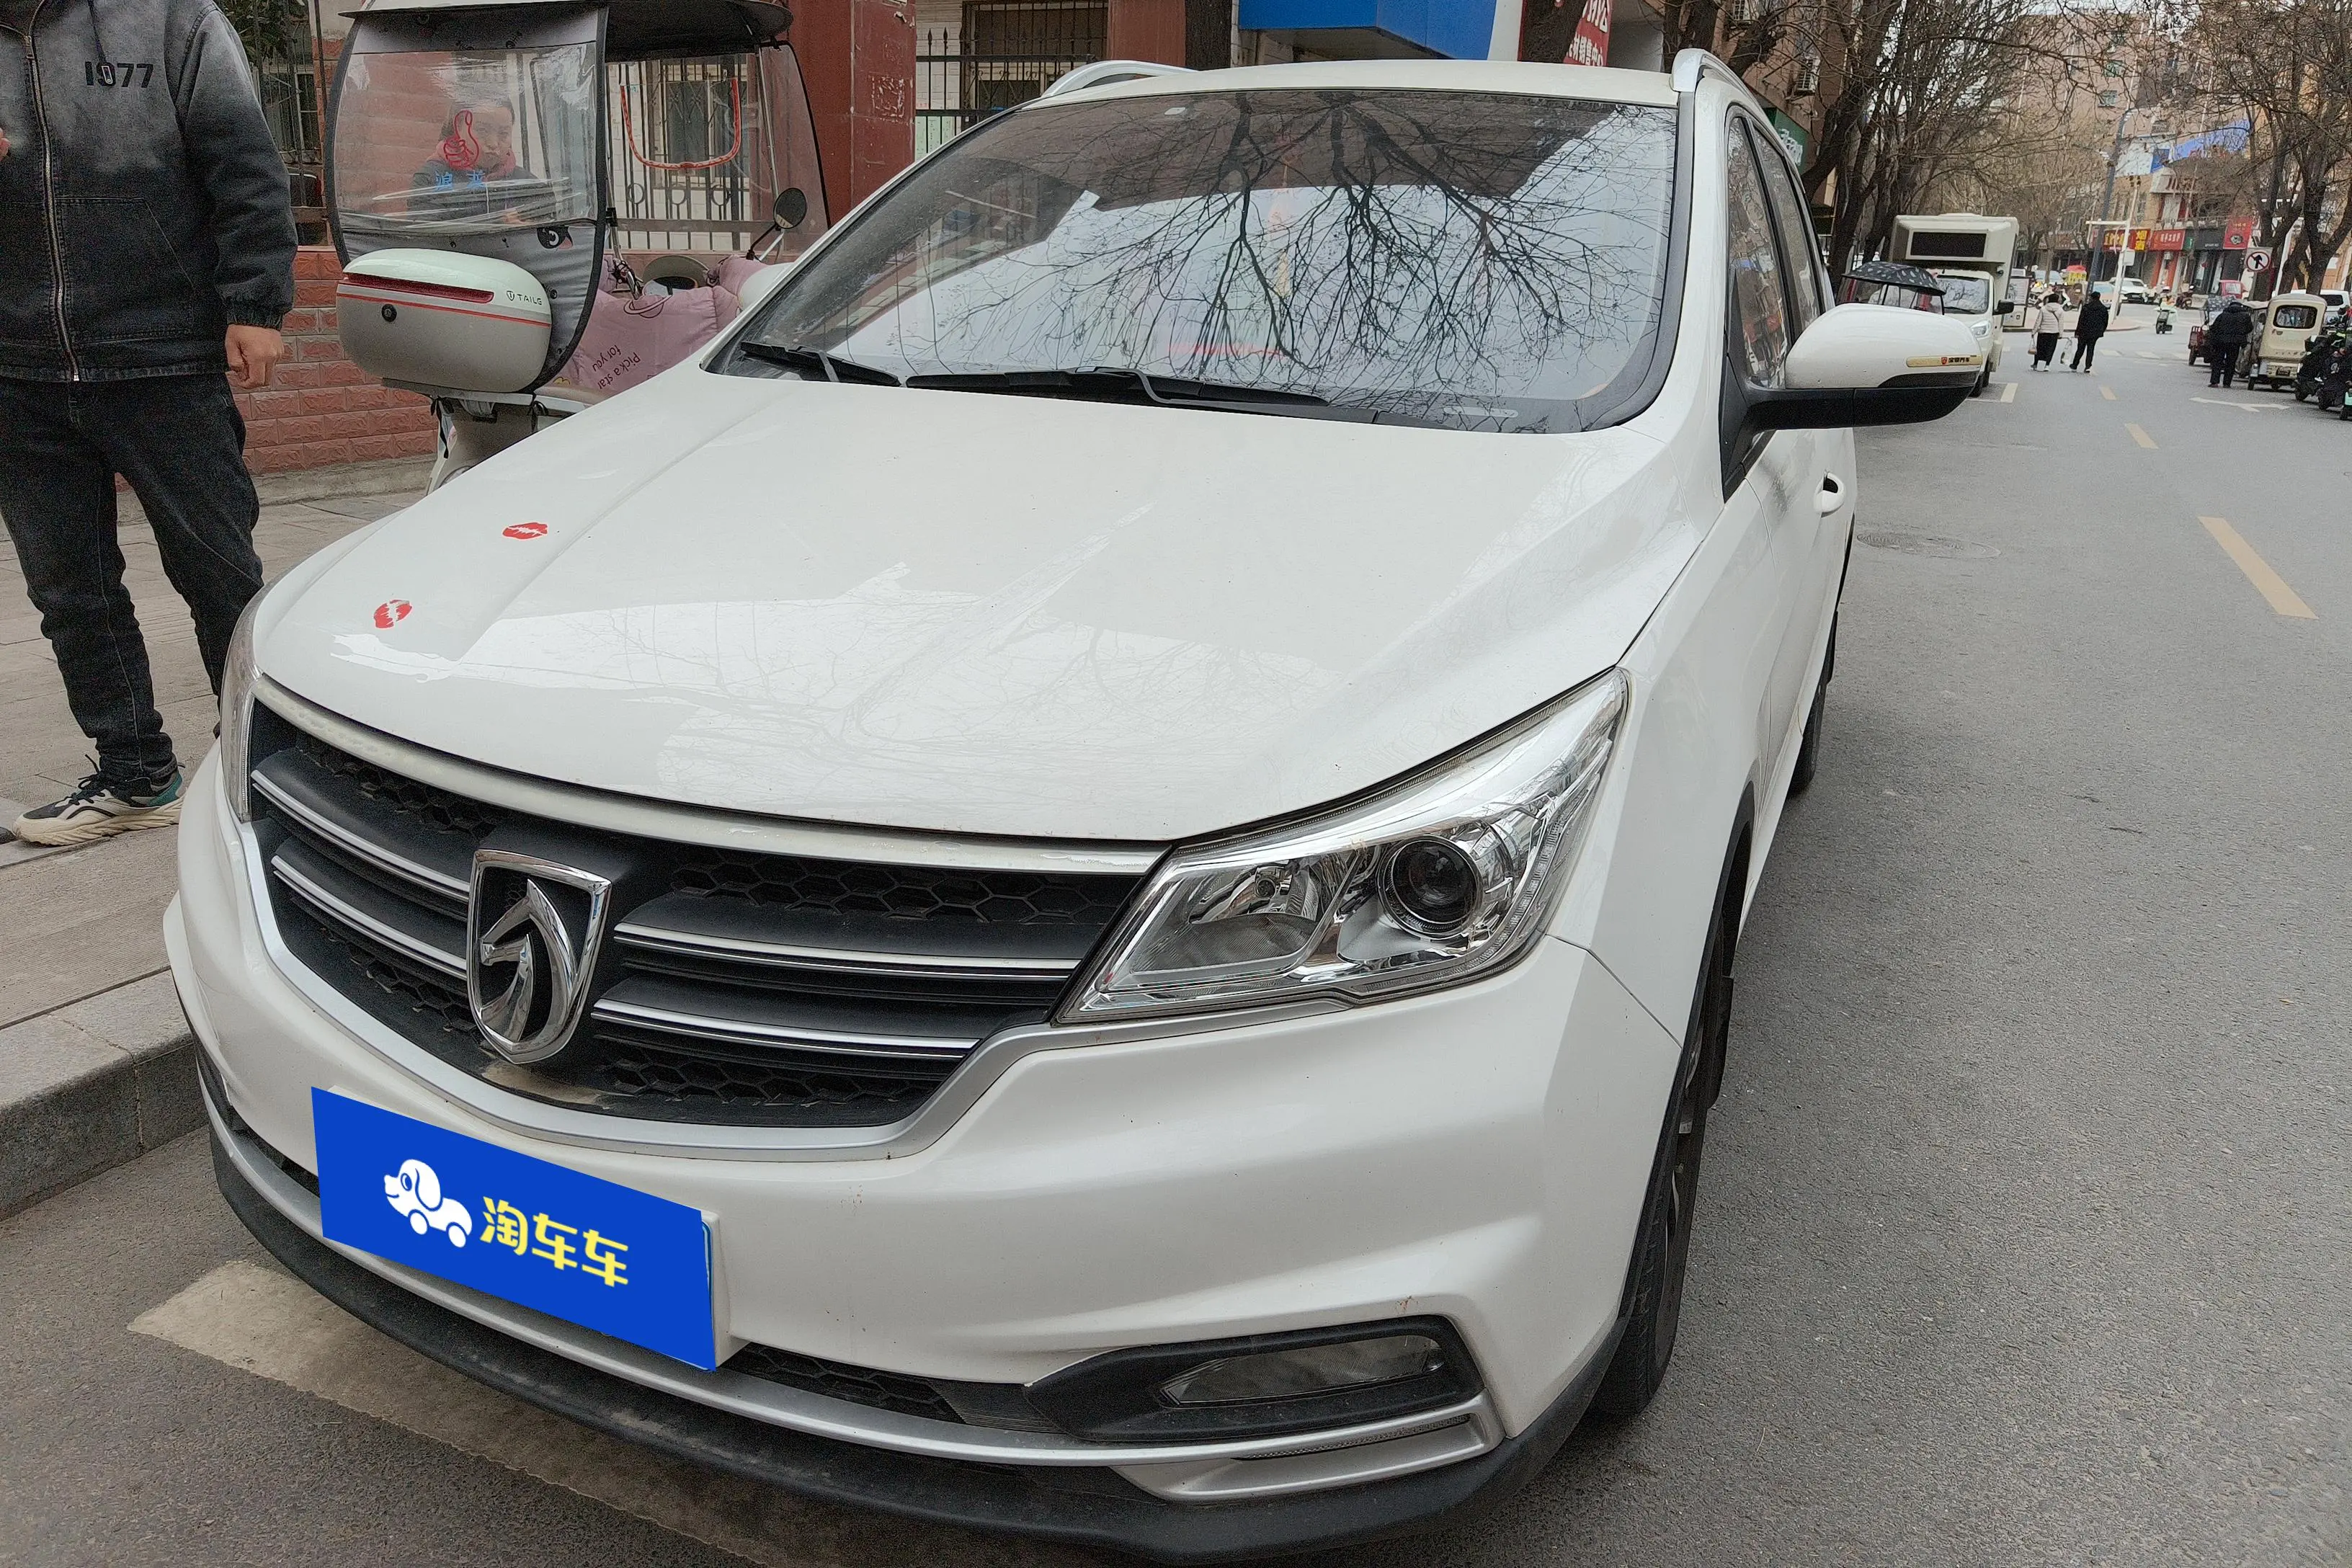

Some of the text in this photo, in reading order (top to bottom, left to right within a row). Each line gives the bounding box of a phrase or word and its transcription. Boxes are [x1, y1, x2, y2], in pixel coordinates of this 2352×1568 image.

[85, 61, 153, 88] 1977
[592, 344, 622, 372] for you
[597, 373, 613, 389] star
